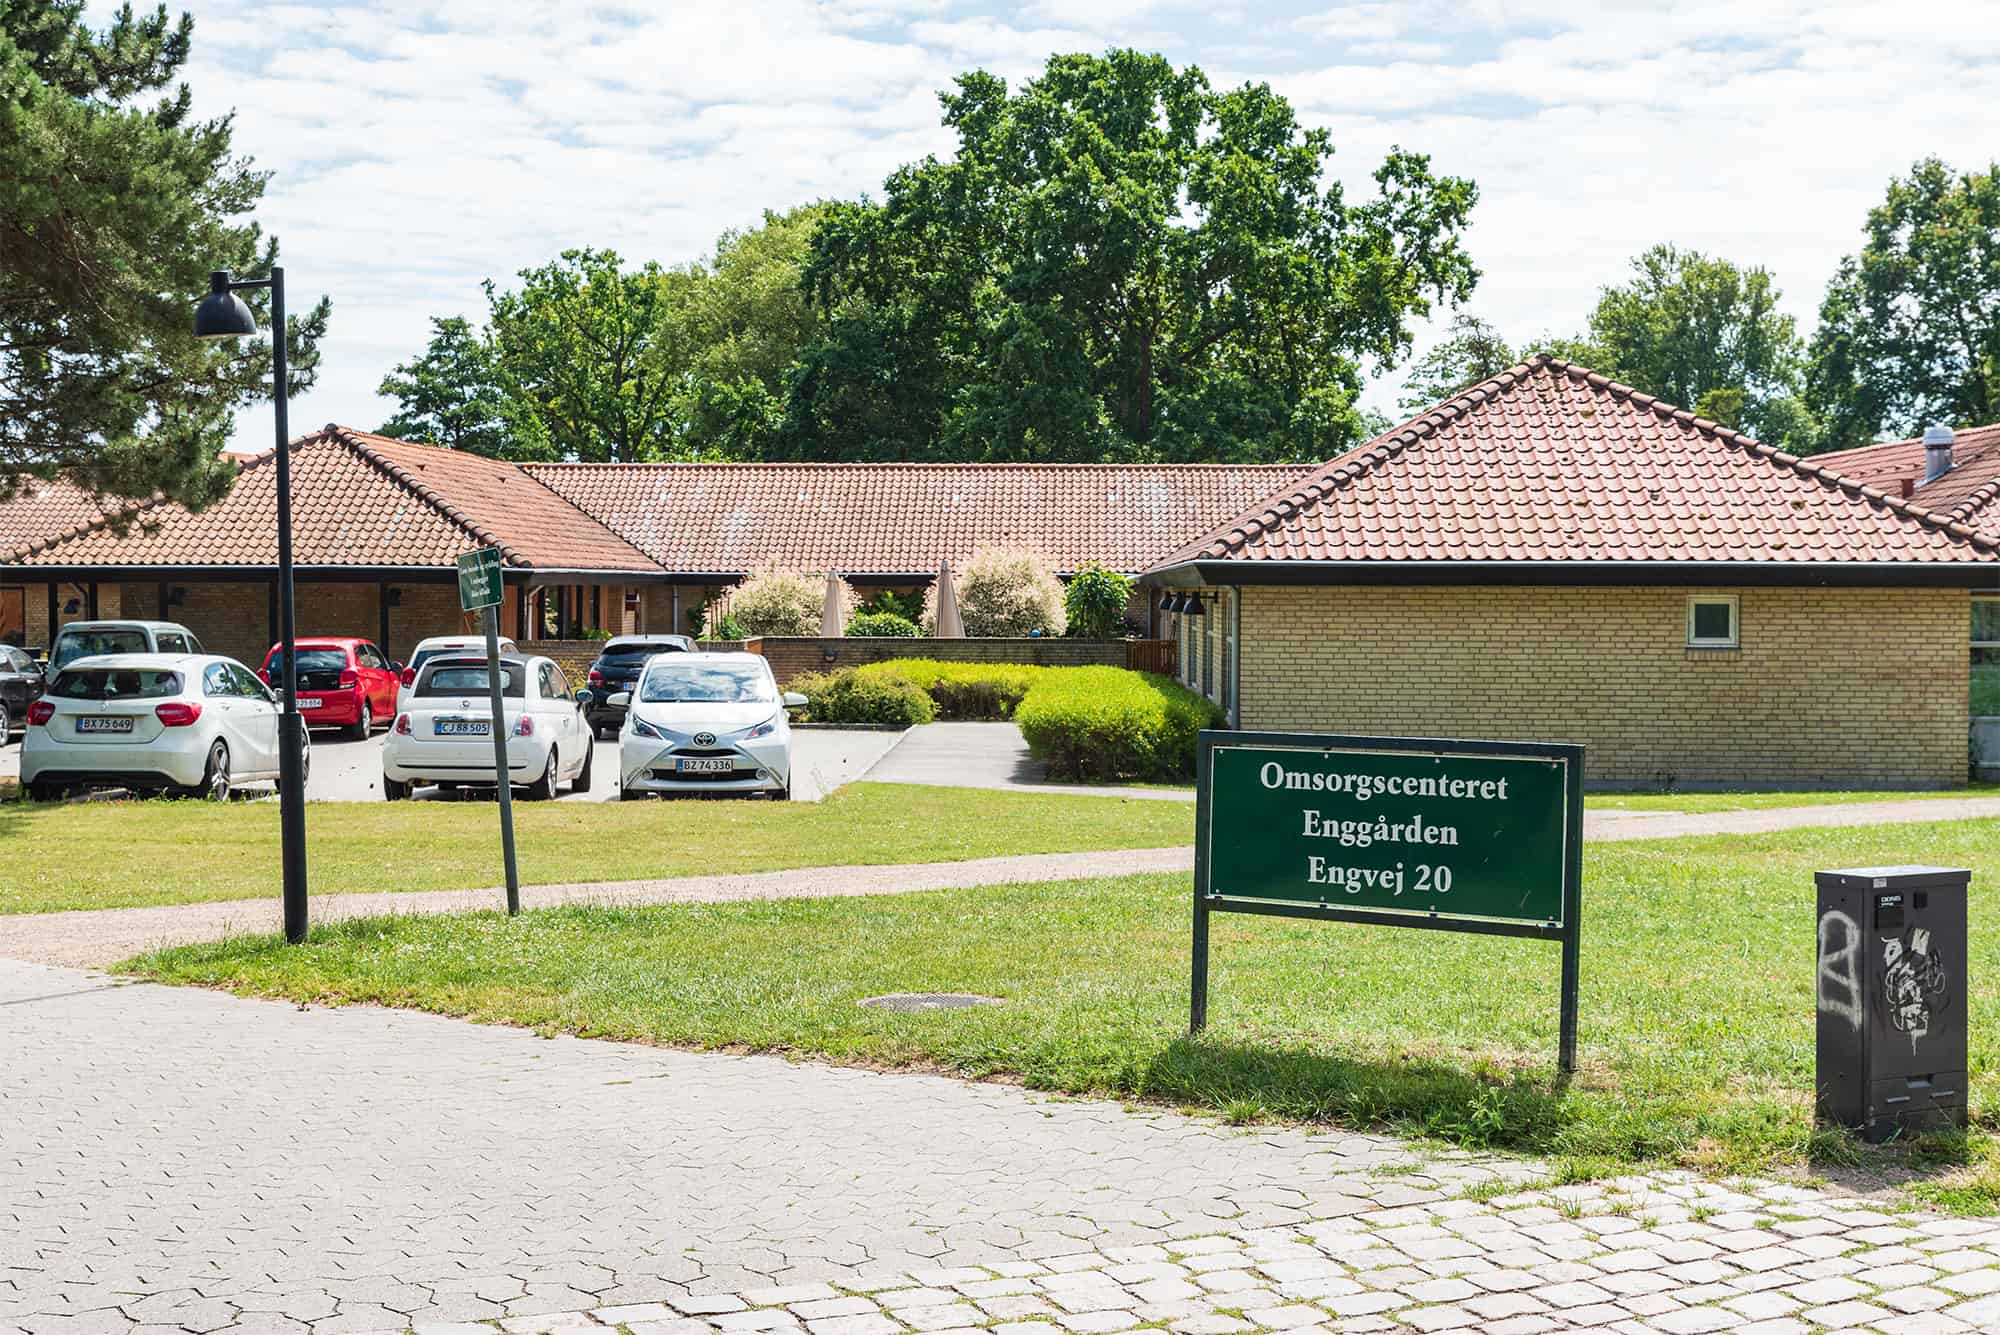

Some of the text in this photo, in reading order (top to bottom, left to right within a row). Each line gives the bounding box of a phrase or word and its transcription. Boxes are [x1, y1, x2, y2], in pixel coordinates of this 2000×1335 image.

[1260, 761, 1509, 801] Omsorgscenteret
[1302, 809, 1459, 847] Enggården
[1307, 856, 1452, 896] Engvej 20
